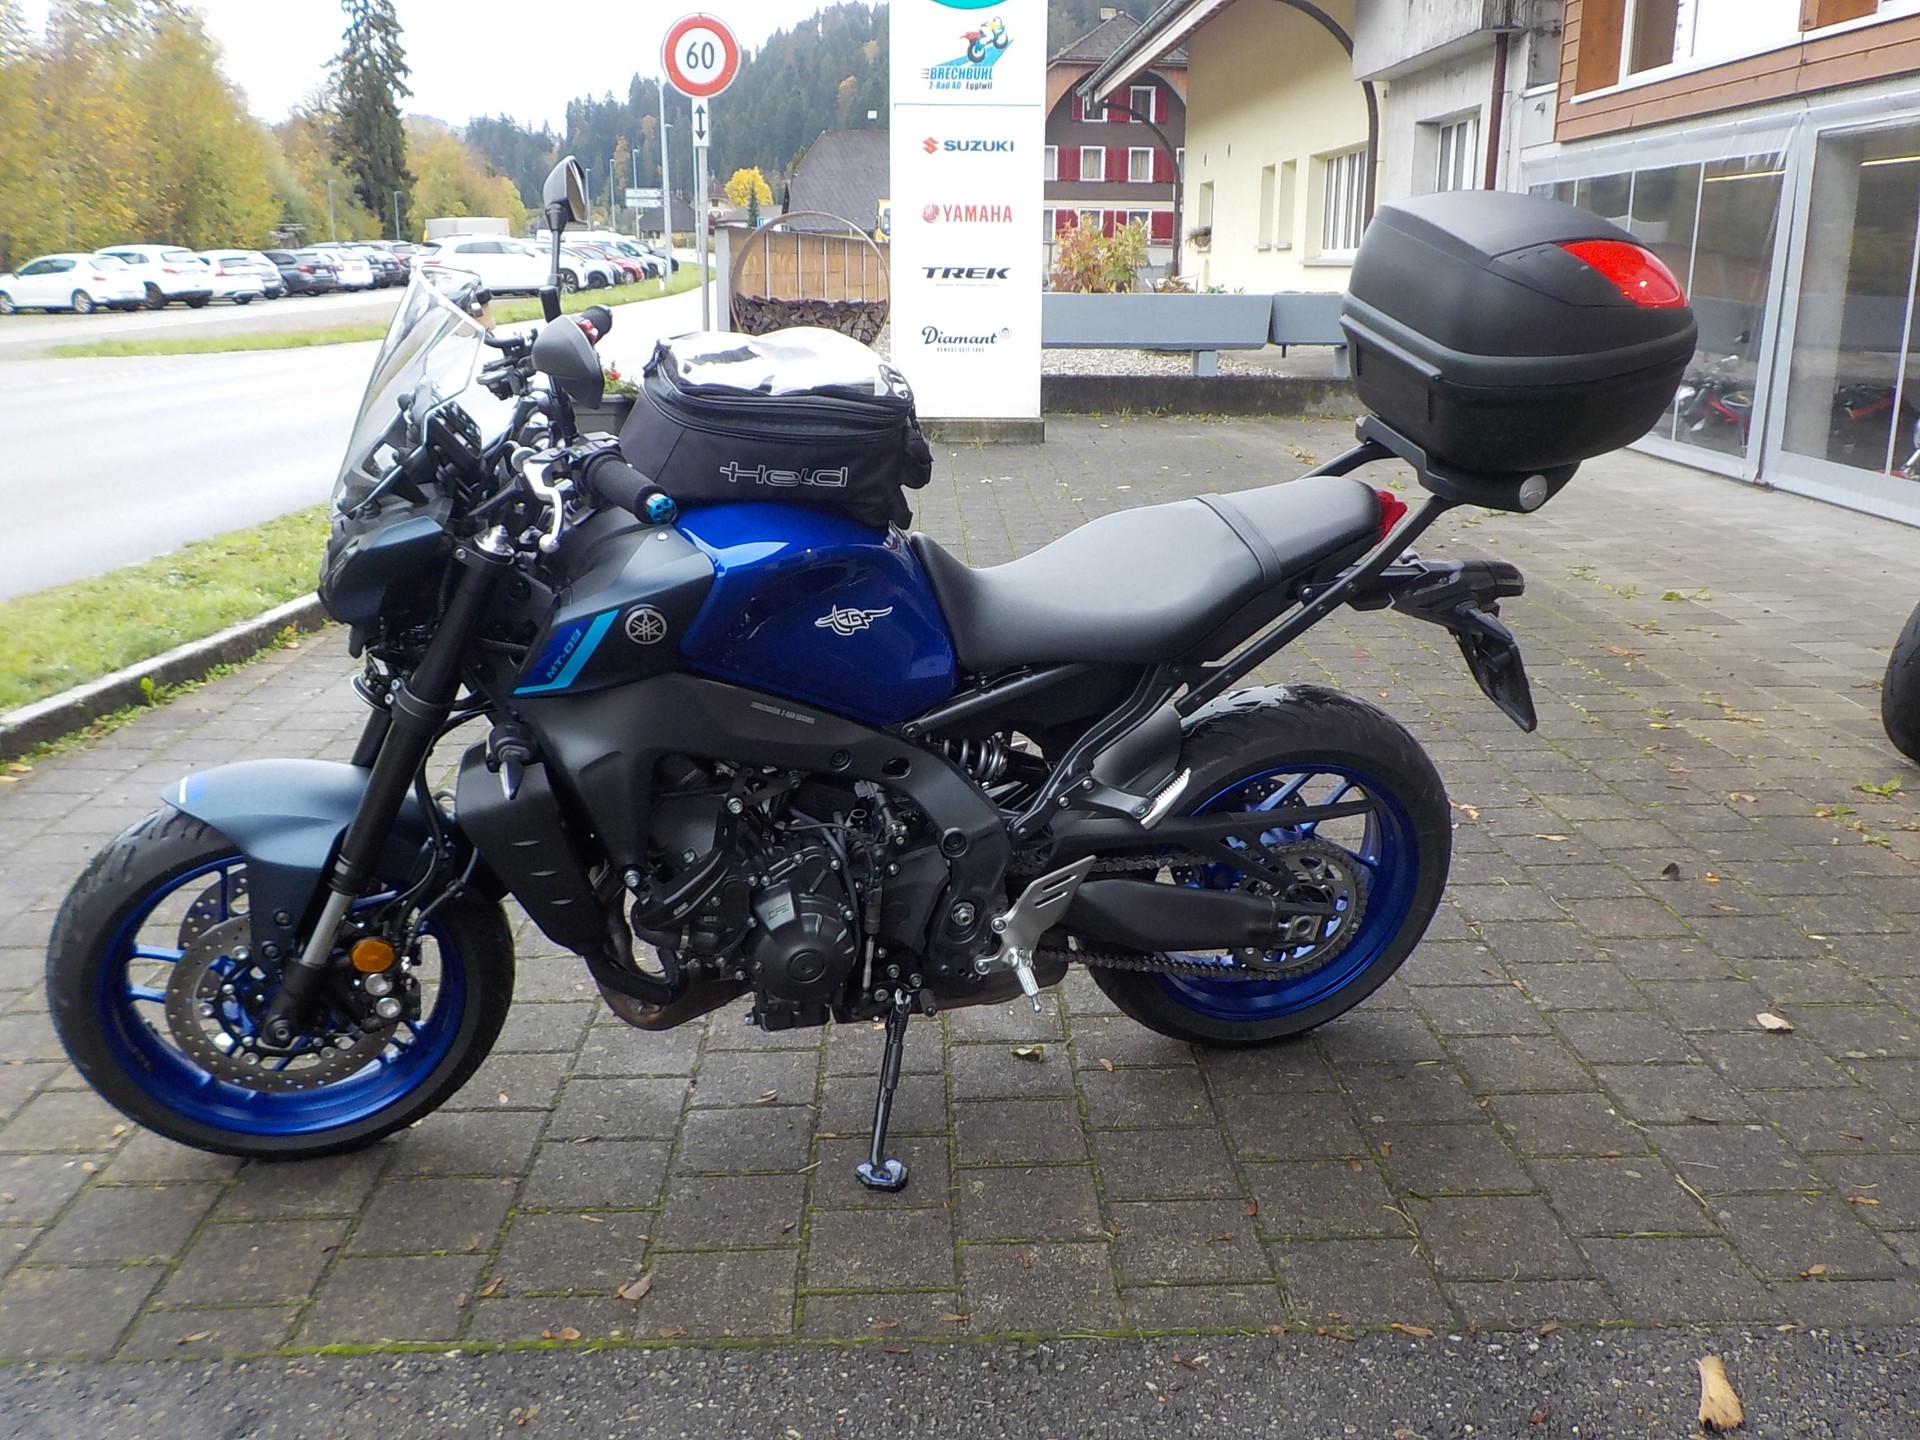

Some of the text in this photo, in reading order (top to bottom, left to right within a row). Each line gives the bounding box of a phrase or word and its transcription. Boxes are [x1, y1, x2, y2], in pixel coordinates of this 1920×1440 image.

[686, 41, 715, 69] 60
[944, 140, 1014, 152] SUZUKI
[943, 204, 1013, 222] YAMAHA
[922, 267, 1011, 279] TREK
[922, 326, 998, 345] Diamant
[720, 461, 848, 488] Held
[546, 628, 581, 679] MT-09
